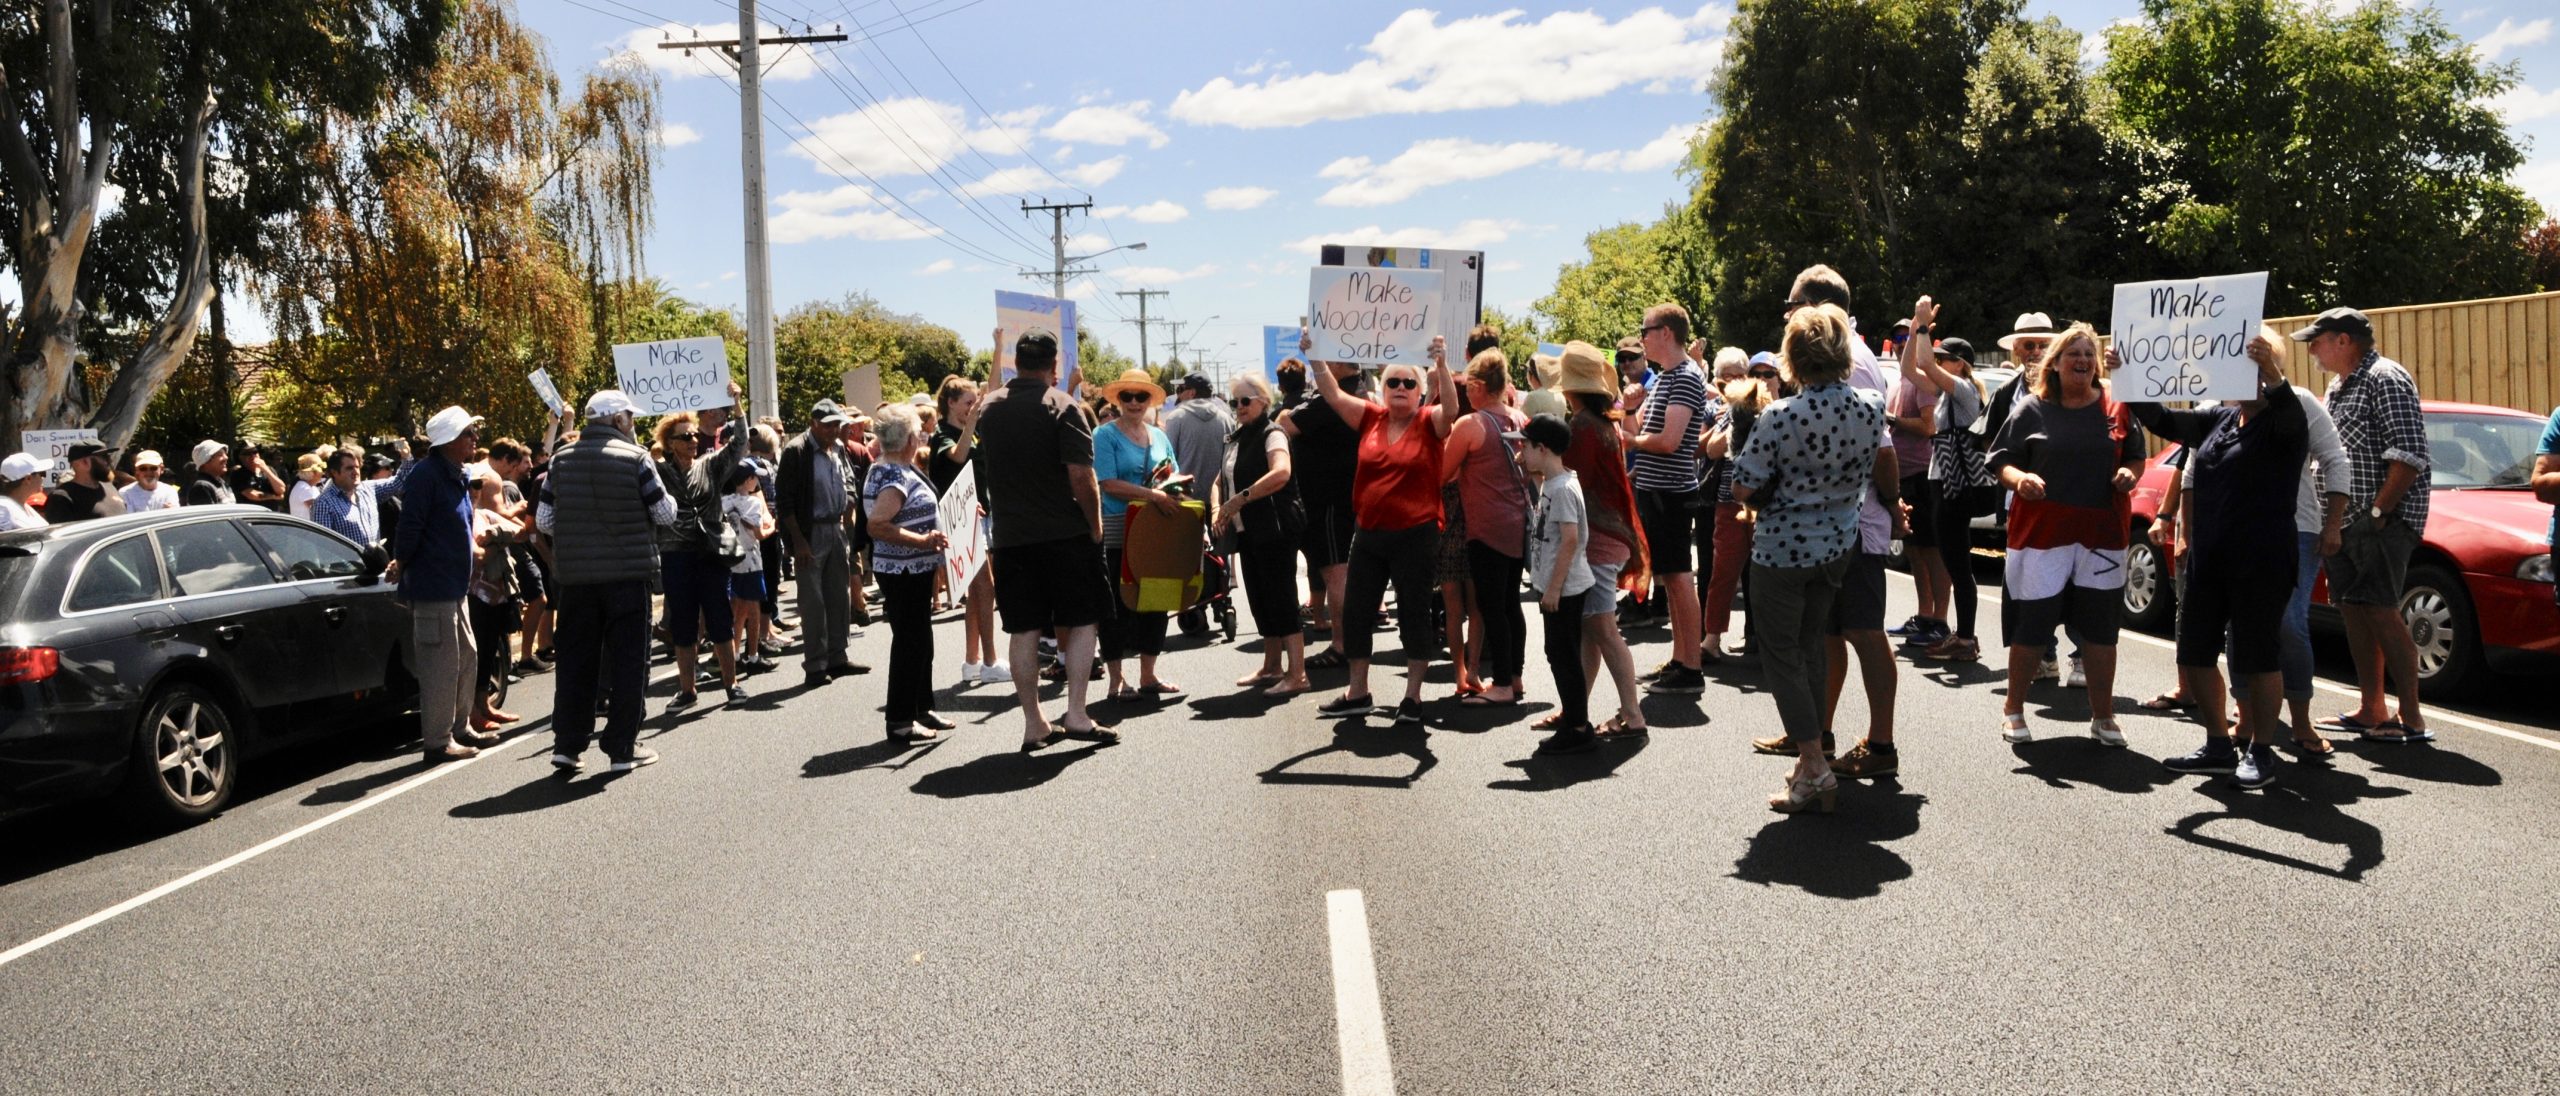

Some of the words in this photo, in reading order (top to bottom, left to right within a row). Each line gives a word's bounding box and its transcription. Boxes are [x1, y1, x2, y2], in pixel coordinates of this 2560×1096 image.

[1348, 271, 1413, 304] Make
[2150, 283, 2225, 320] Make
[1312, 300, 1429, 331] Woodend
[648, 342, 704, 367] Make
[1338, 331, 1400, 360] Safe
[2114, 319, 2247, 365] Woodend
[620, 362, 718, 396] Woodend
[2145, 362, 2208, 398] Safe
[651, 387, 705, 413] Safe
